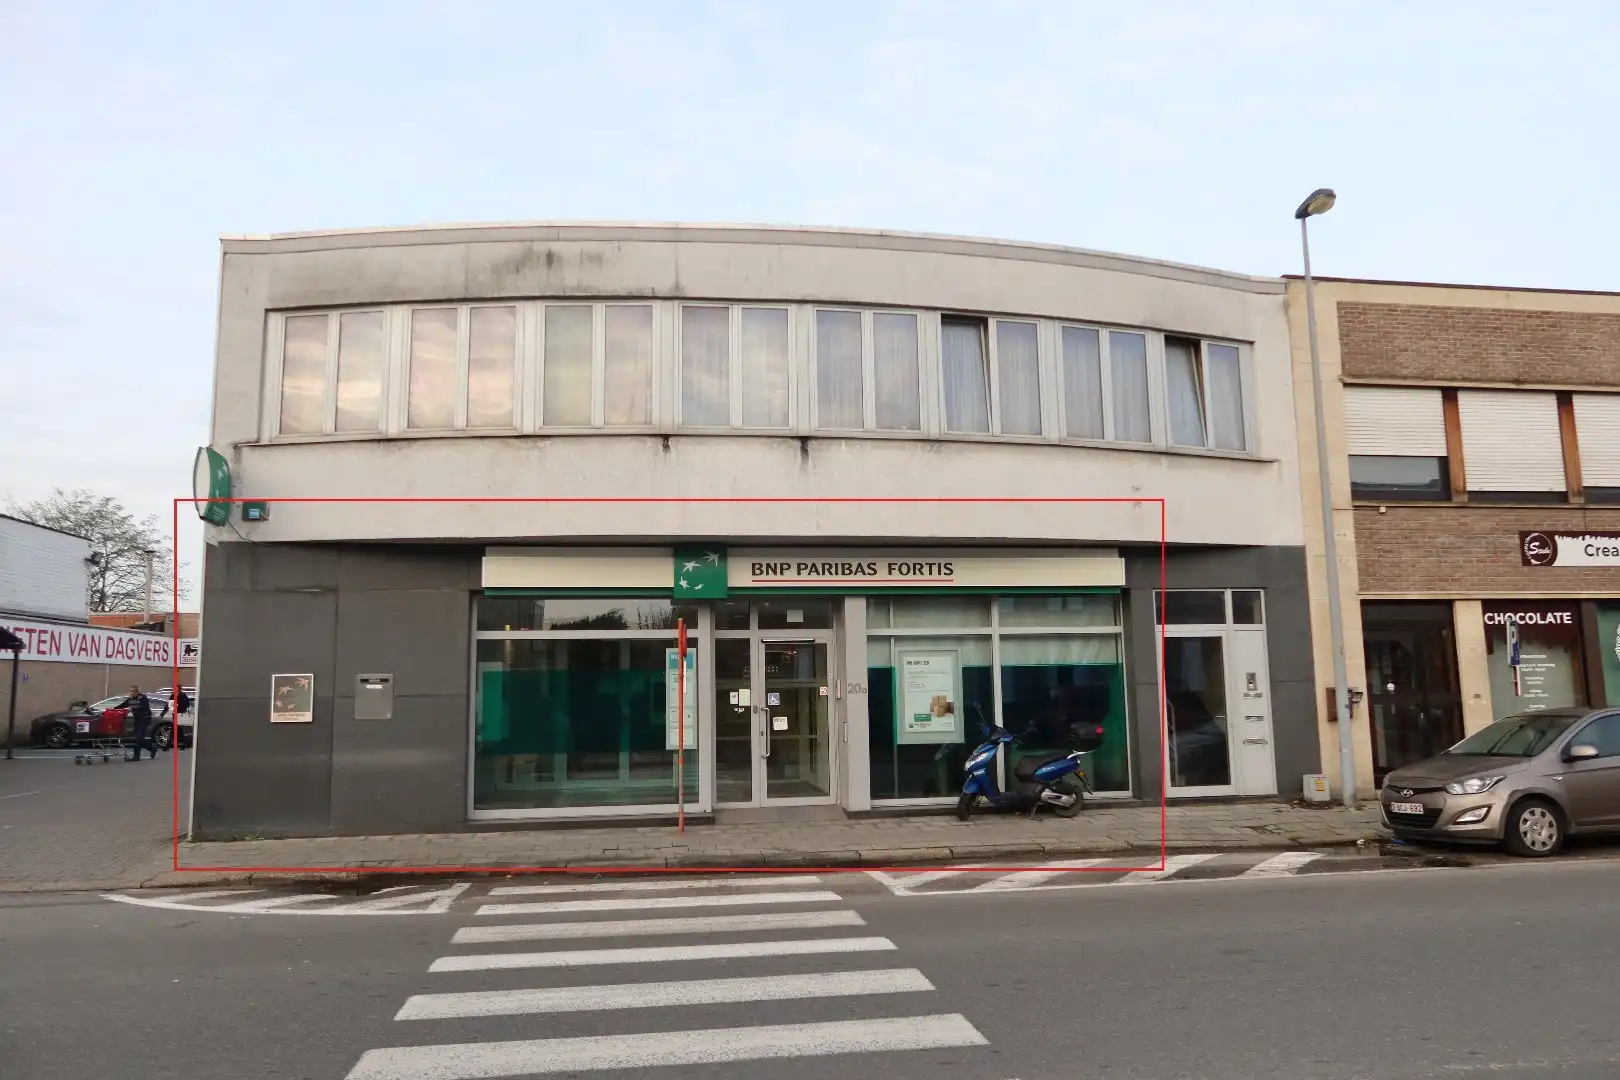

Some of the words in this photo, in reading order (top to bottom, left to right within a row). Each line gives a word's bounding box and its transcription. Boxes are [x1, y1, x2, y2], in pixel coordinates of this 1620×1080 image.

[1584, 543, 1620, 557] Crea
[751, 562, 792, 576] BNP
[796, 562, 878, 576] PARIBAS
[887, 562, 954, 576] FORTIS
[1483, 611, 1573, 625] CHOCOLATE
[68, 631, 101, 659] VAN
[105, 636, 169, 662] DAGVERS
[847, 682, 868, 694] 20a
